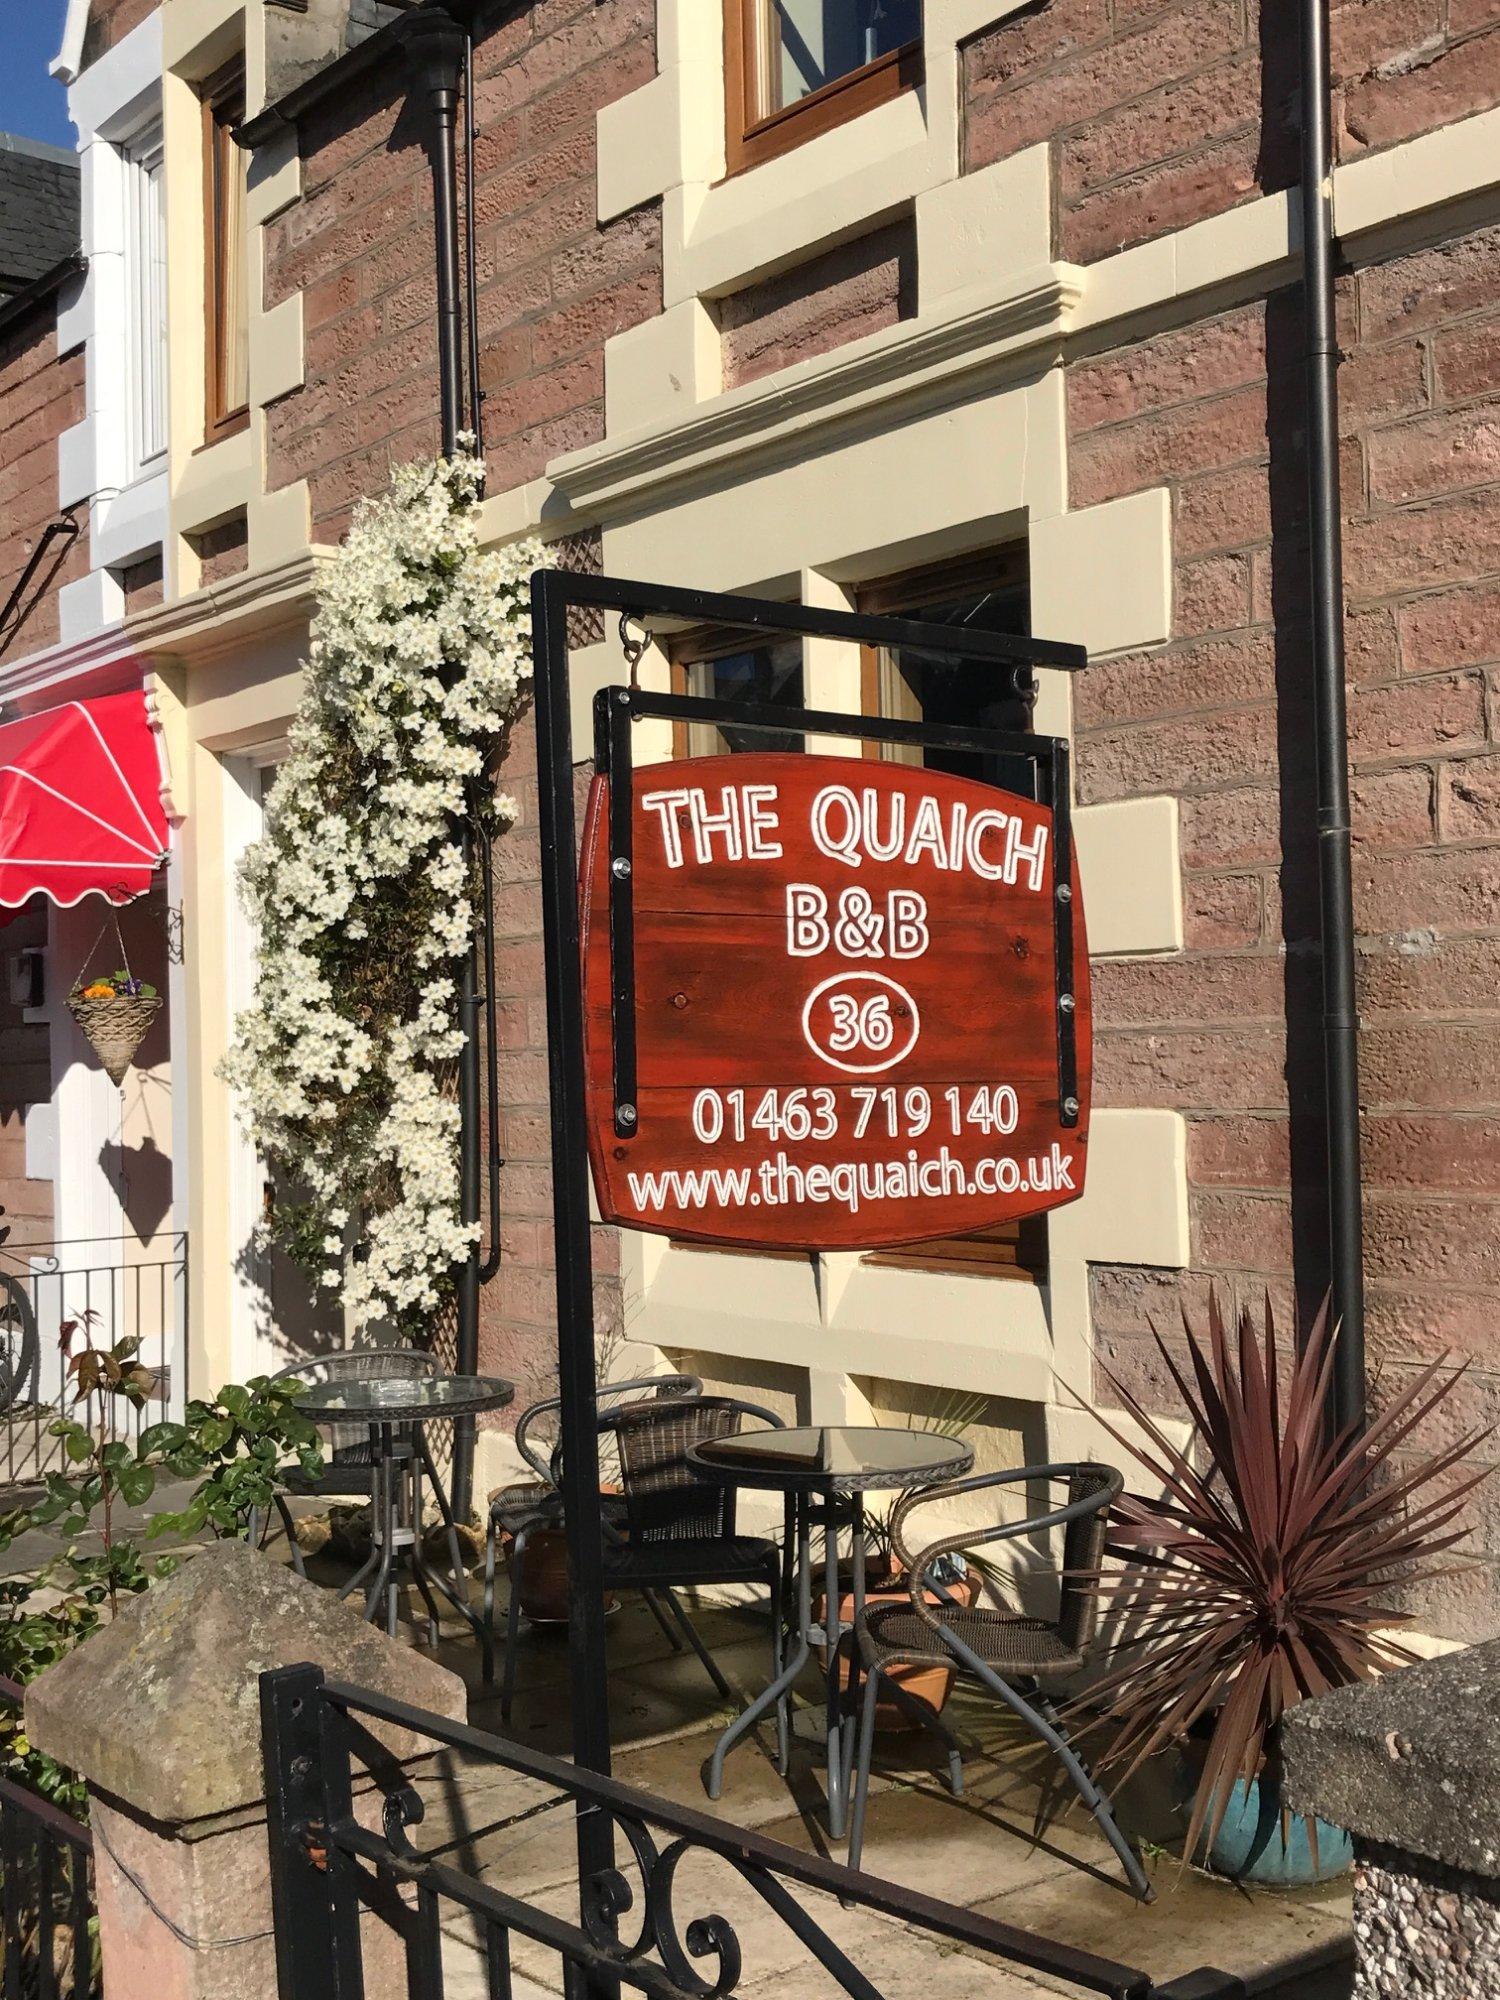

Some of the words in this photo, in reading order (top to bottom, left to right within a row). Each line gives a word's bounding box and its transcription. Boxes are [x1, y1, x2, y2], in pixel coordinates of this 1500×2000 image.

[642, 785, 783, 868] THE
[811, 785, 1049, 891] QUAICH
[786, 883, 929, 958] B&B
[828, 994, 893, 1051] 36
[692, 1086, 837, 1143] 01463
[851, 1086, 931, 1138] 719
[945, 1085, 1018, 1136] 140
[627, 1143, 1075, 1212] www.thequaich.co.uk
